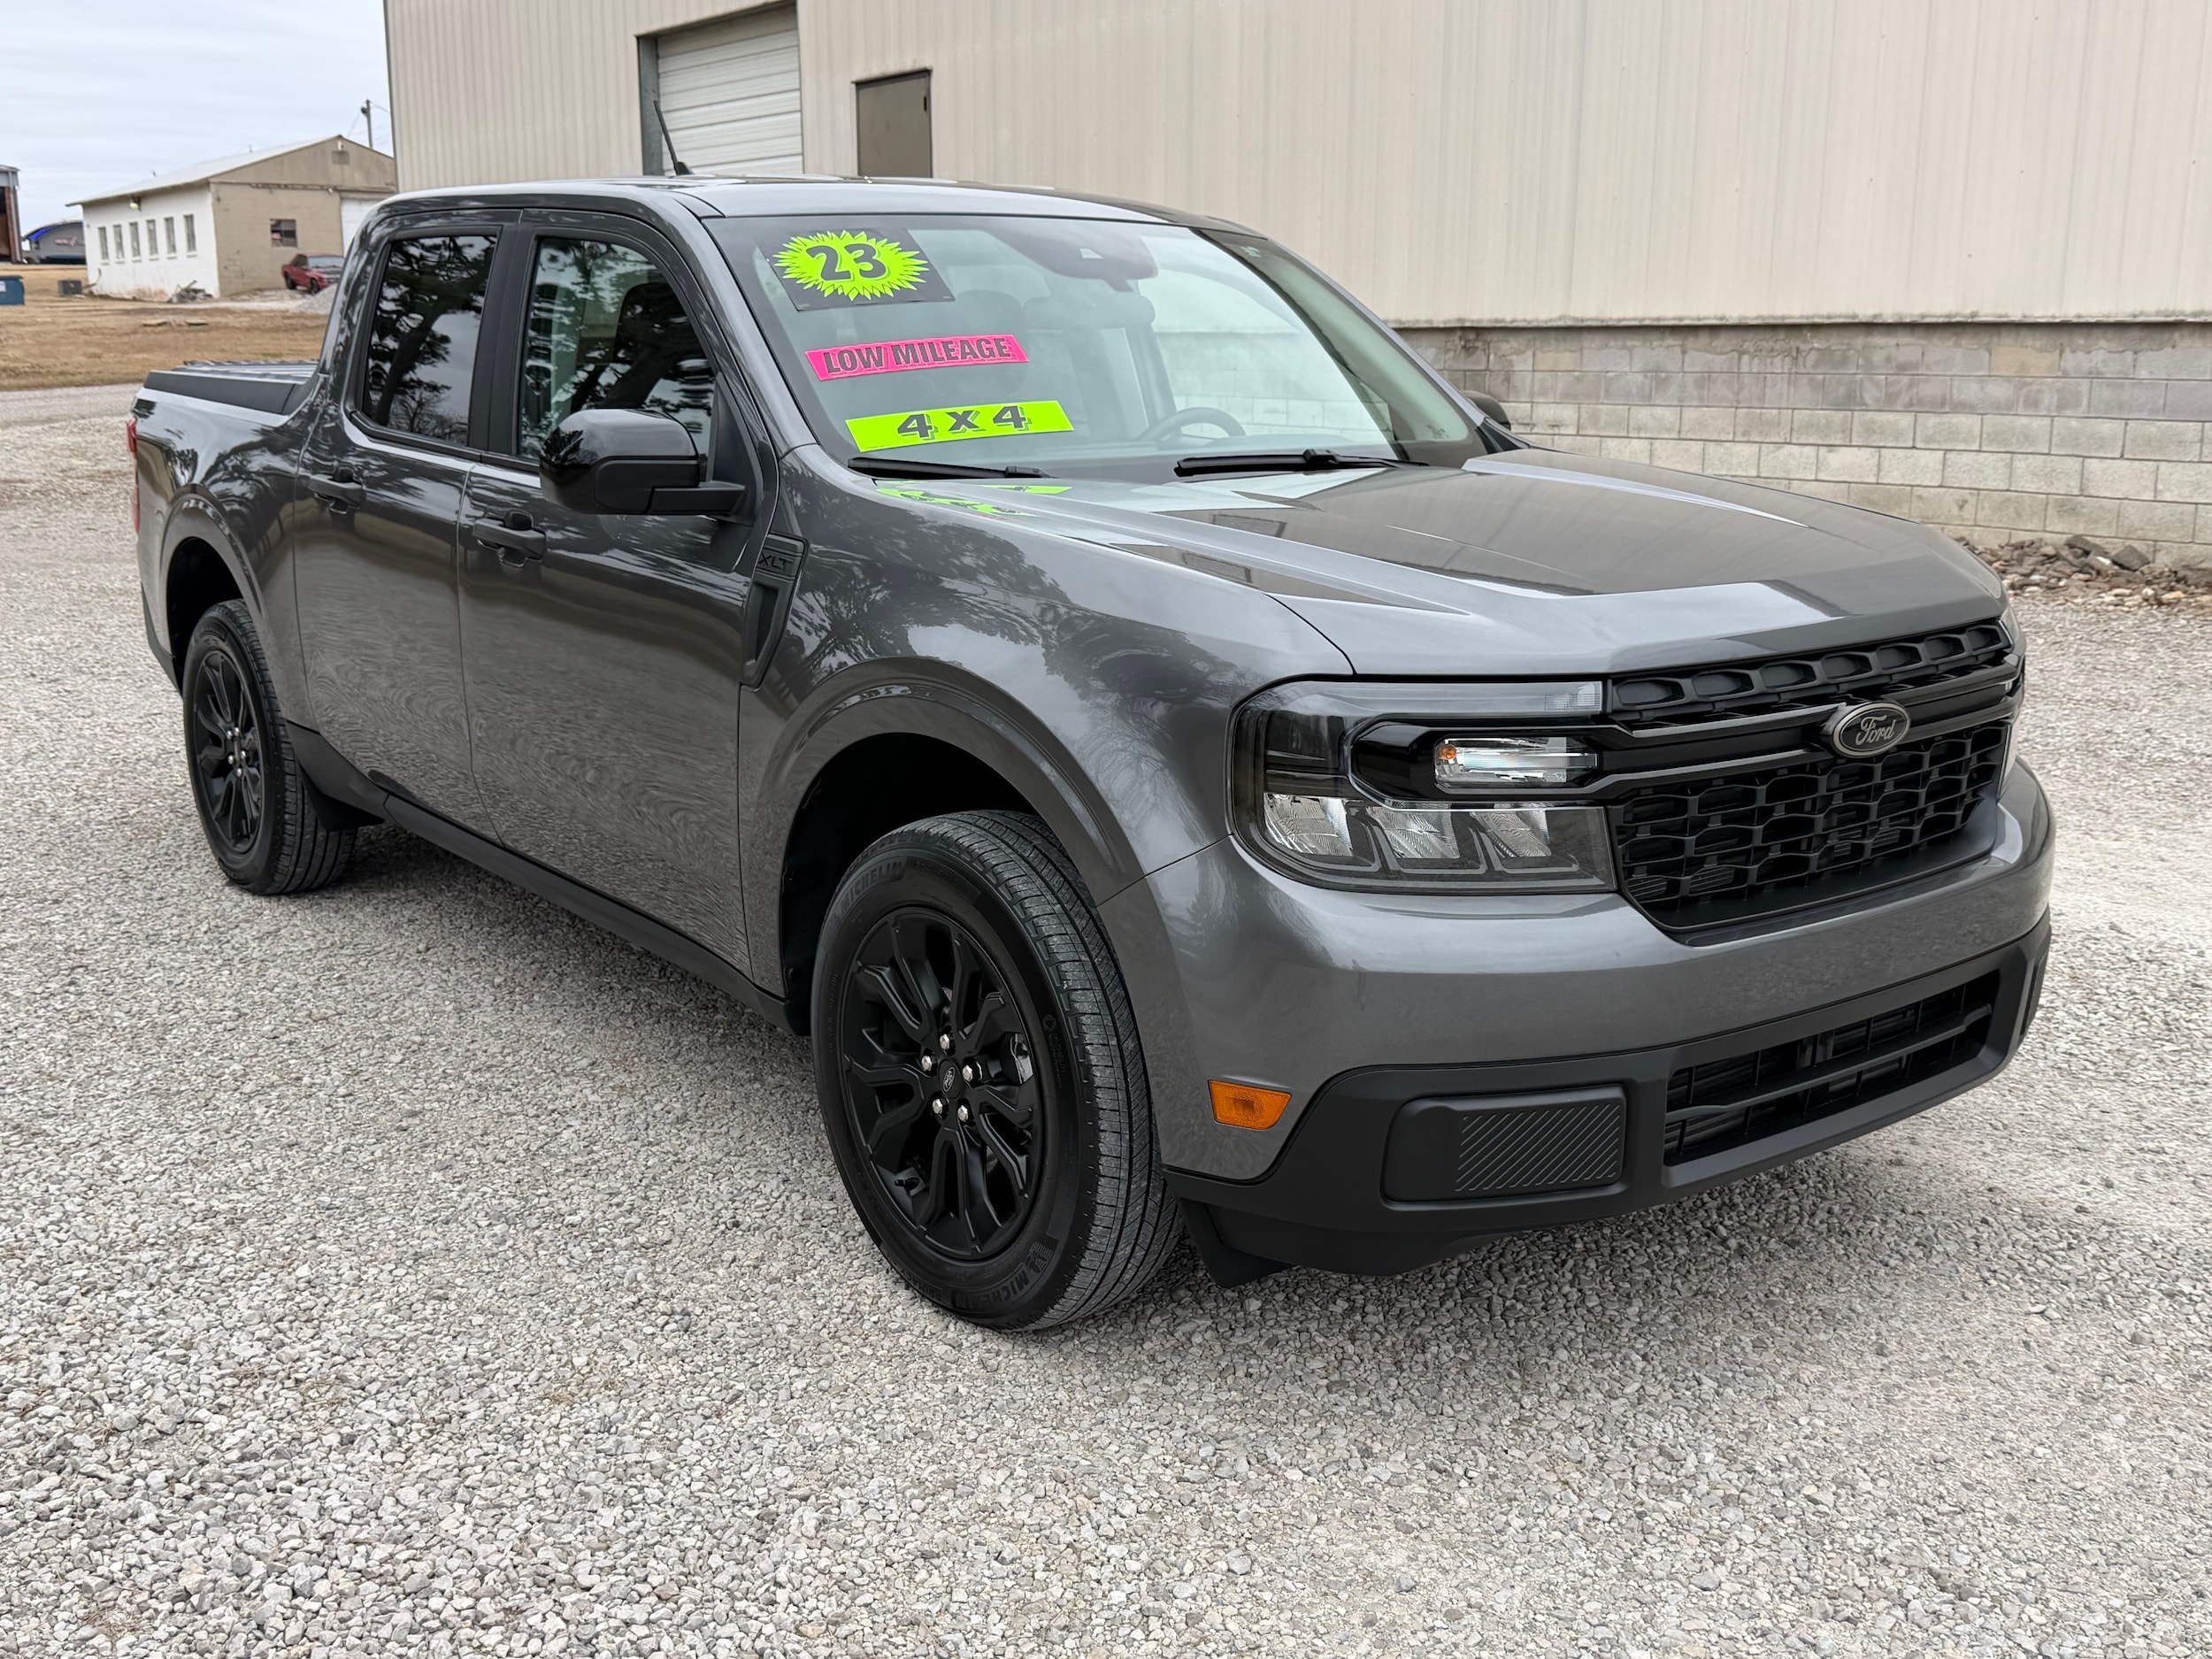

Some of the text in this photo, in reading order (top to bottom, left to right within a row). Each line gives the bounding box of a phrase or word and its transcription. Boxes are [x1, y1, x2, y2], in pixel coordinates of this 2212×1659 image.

[805, 242, 887, 282] 23
[822, 337, 1012, 375] LOW MILEAGE
[896, 412, 935, 440] 4
[991, 404, 1029, 431] 4
[758, 552, 793, 571] XLT
[1855, 714, 1897, 746] Ford
[840, 861, 902, 916] MICHELIN
